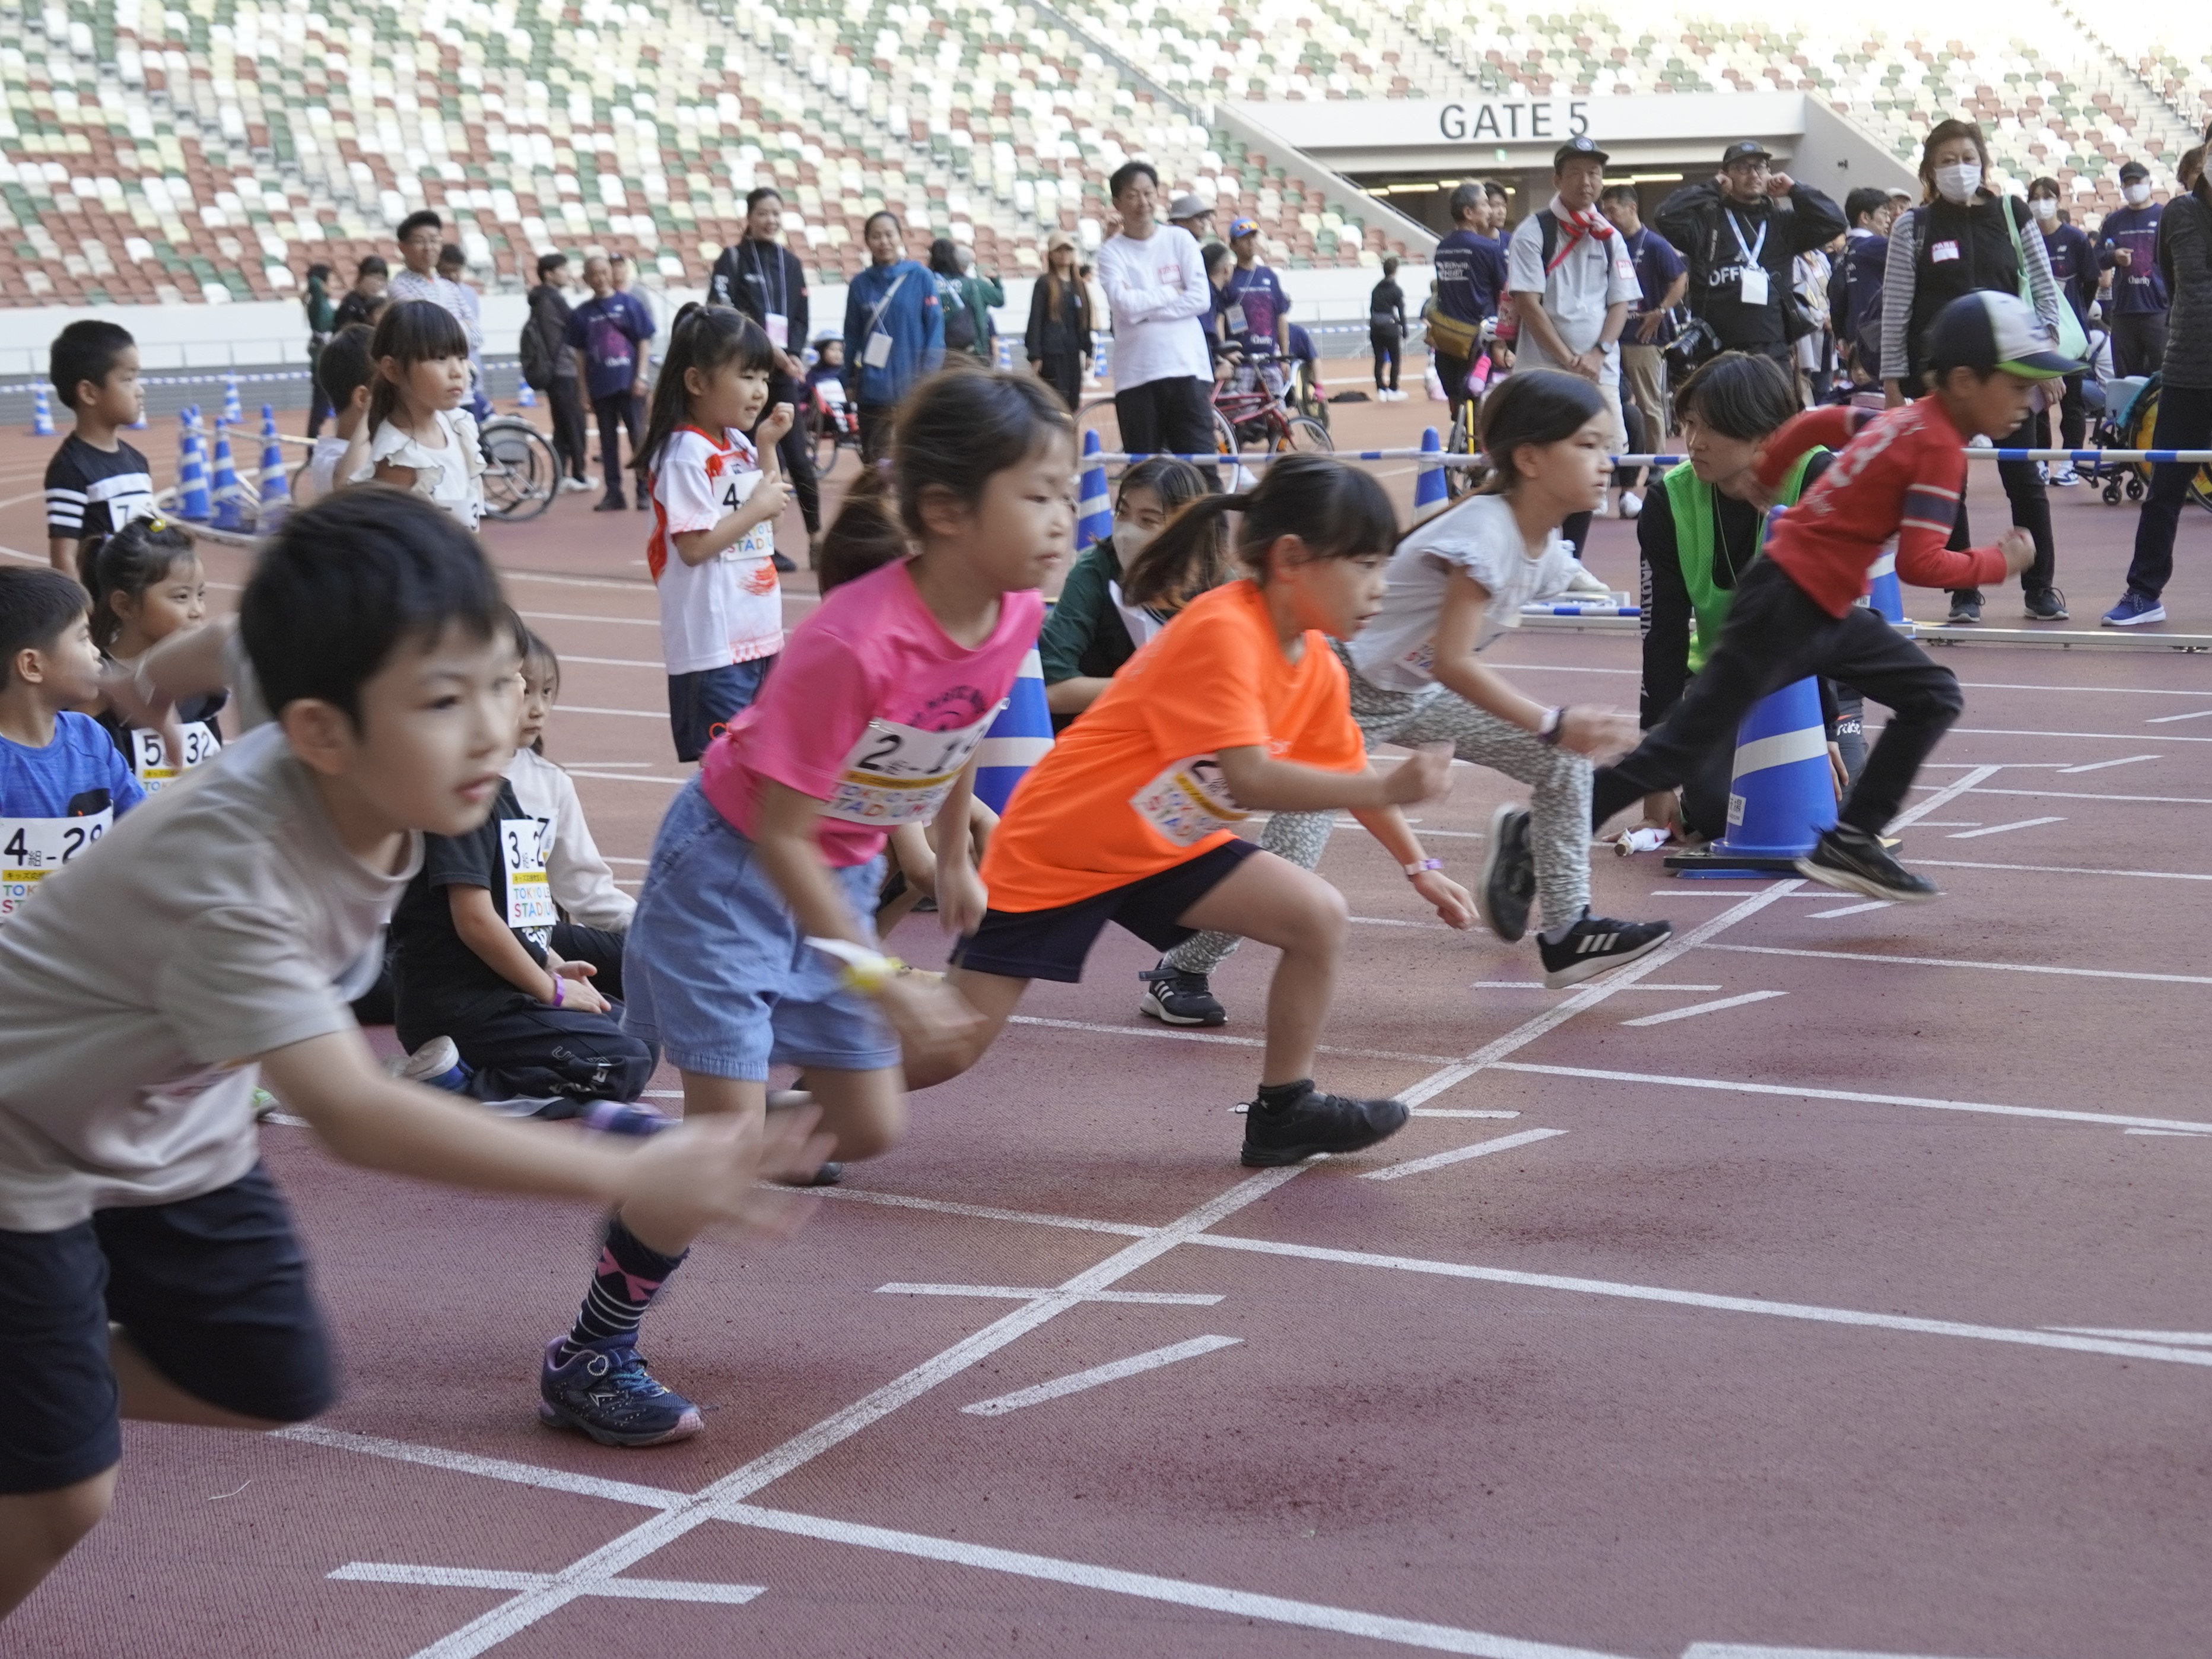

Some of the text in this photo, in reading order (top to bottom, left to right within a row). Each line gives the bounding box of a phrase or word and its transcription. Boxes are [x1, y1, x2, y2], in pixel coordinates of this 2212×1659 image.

[1439, 102, 1589, 139] GATE 5
[2128, 275, 2151, 287] Charity
[723, 482, 740, 511] 4
[514, 887, 542, 900] TOKYO
